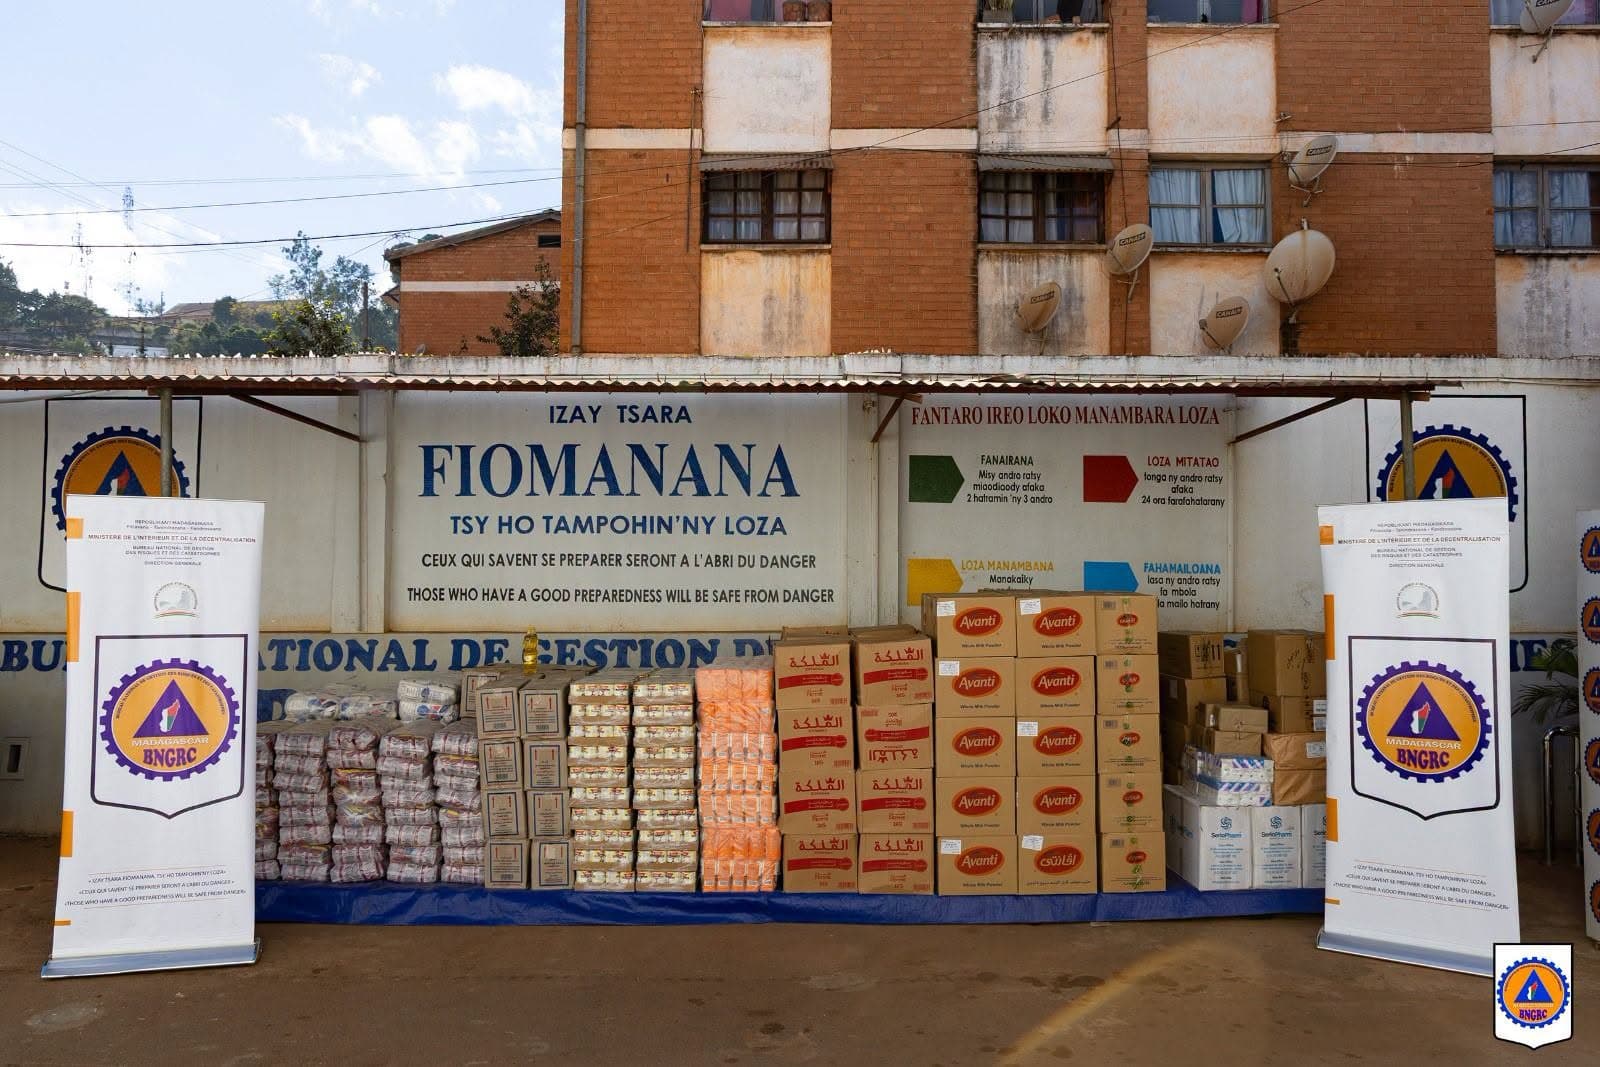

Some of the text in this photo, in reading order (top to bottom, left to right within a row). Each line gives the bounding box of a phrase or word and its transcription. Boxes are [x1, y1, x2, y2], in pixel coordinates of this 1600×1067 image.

[550, 405, 692, 423] IZAY TSARA
[912, 406, 1219, 424] FANTARO IREO LOKO MANAMBARA LOZA
[981, 455, 1033, 466] FANAIRANA
[1148, 456, 1219, 467] LOZA MITATAO
[418, 443, 800, 497] FIOMANANA
[979, 470, 1041, 482] Misy andro ratsy
[1144, 472, 1223, 484] tonga ny andro ratsy
[1172, 485, 1193, 493] afaka
[450, 515, 787, 535] TSY HO TAMPOHIN'NY LOZA
[422, 553, 815, 568] CEUX QUI SAVENT SE PREPARER SERONT A L'ABRI DU DANGER
[962, 560, 1054, 571] LOZA MANAMBANA
[1144, 563, 1220, 574] FAHAMAILOANA
[990, 574, 1033, 585] Manakaiky
[1148, 575, 1220, 587] lasa ny andro ratsy
[408, 588, 834, 603] THOSE WHO HAVE A GOOD PREPAREDNESS WILL BE SAFE FROM DANGER
[1160, 587, 1196, 596] fa mbola
[1167, 599, 1188, 608] mailo
[1191, 600, 1219, 610] hatrany
[960, 614, 996, 629] Avanti
[1040, 614, 1076, 630] Avanti
[448, 639, 510, 671] DE
[959, 674, 995, 690] Avanti
[1038, 673, 1074, 689] Avanti
[132, 737, 208, 746] MADAGASCAR
[960, 733, 996, 749] Avanti
[1040, 732, 1076, 748] Avanti
[1386, 738, 1462, 750] MADAGASCAR
[143, 748, 197, 767] BNGRC
[1396, 749, 1450, 769] BNGRC
[959, 794, 995, 809] Avanti
[1040, 794, 1076, 808] Avanti
[962, 854, 998, 869] Avanti
